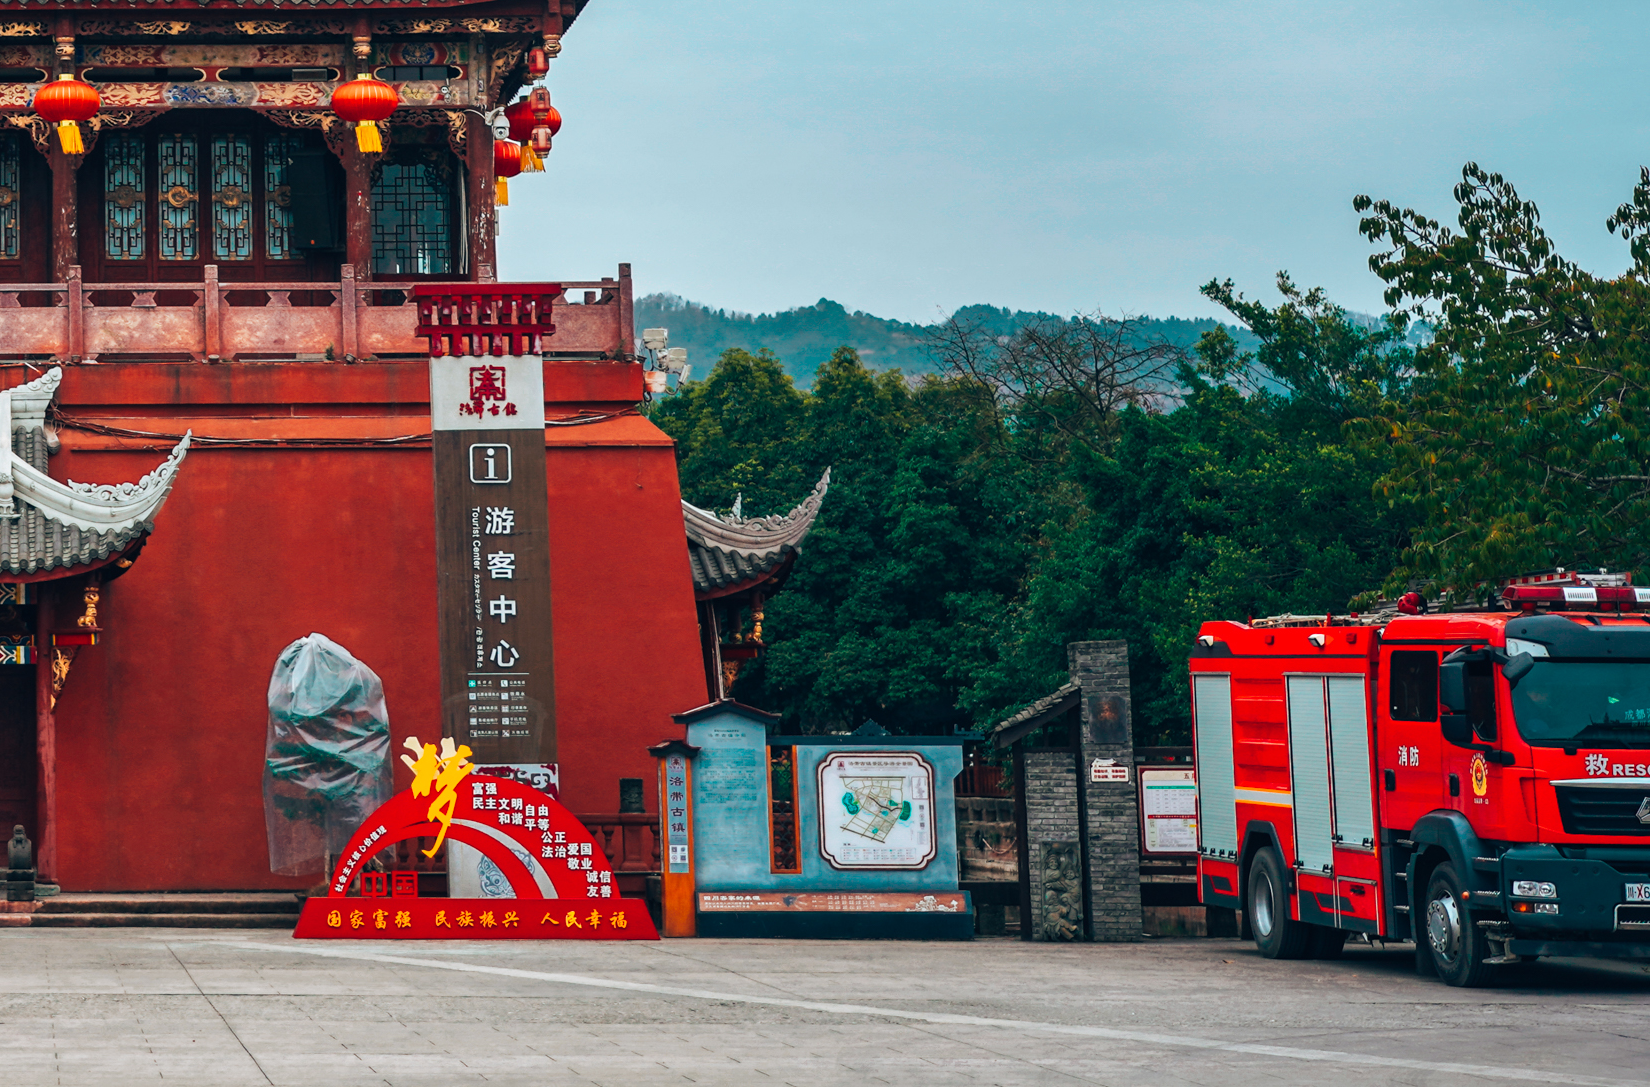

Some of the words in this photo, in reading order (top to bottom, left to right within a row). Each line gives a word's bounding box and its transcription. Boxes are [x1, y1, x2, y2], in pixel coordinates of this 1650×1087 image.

[472, 506, 481, 538] Tourist
[472, 540, 481, 570] Center
[485, 506, 520, 667] 游客中心
[1398, 745, 1419, 767] 消防
[1585, 753, 1610, 776] 救
[471, 782, 498, 795] 富强
[472, 797, 497, 810] 民主
[498, 798, 523, 810] 文明
[525, 804, 549, 817] 自由
[498, 812, 524, 825] 和谐
[524, 818, 550, 831] 平等
[541, 831, 567, 844] 公正
[541, 845, 567, 858] 法治
[567, 843, 592, 856] 爱国
[334, 825, 387, 892] 社会主义核心价值观
[567, 857, 593, 870] 敬业
[586, 870, 611, 883] 诚信
[360, 870, 419, 898] 中国
[586, 885, 612, 898] 友善
[327, 909, 413, 929] 国家富强
[435, 909, 520, 929] 民族振兴
[540, 909, 628, 930] 人民幸福
